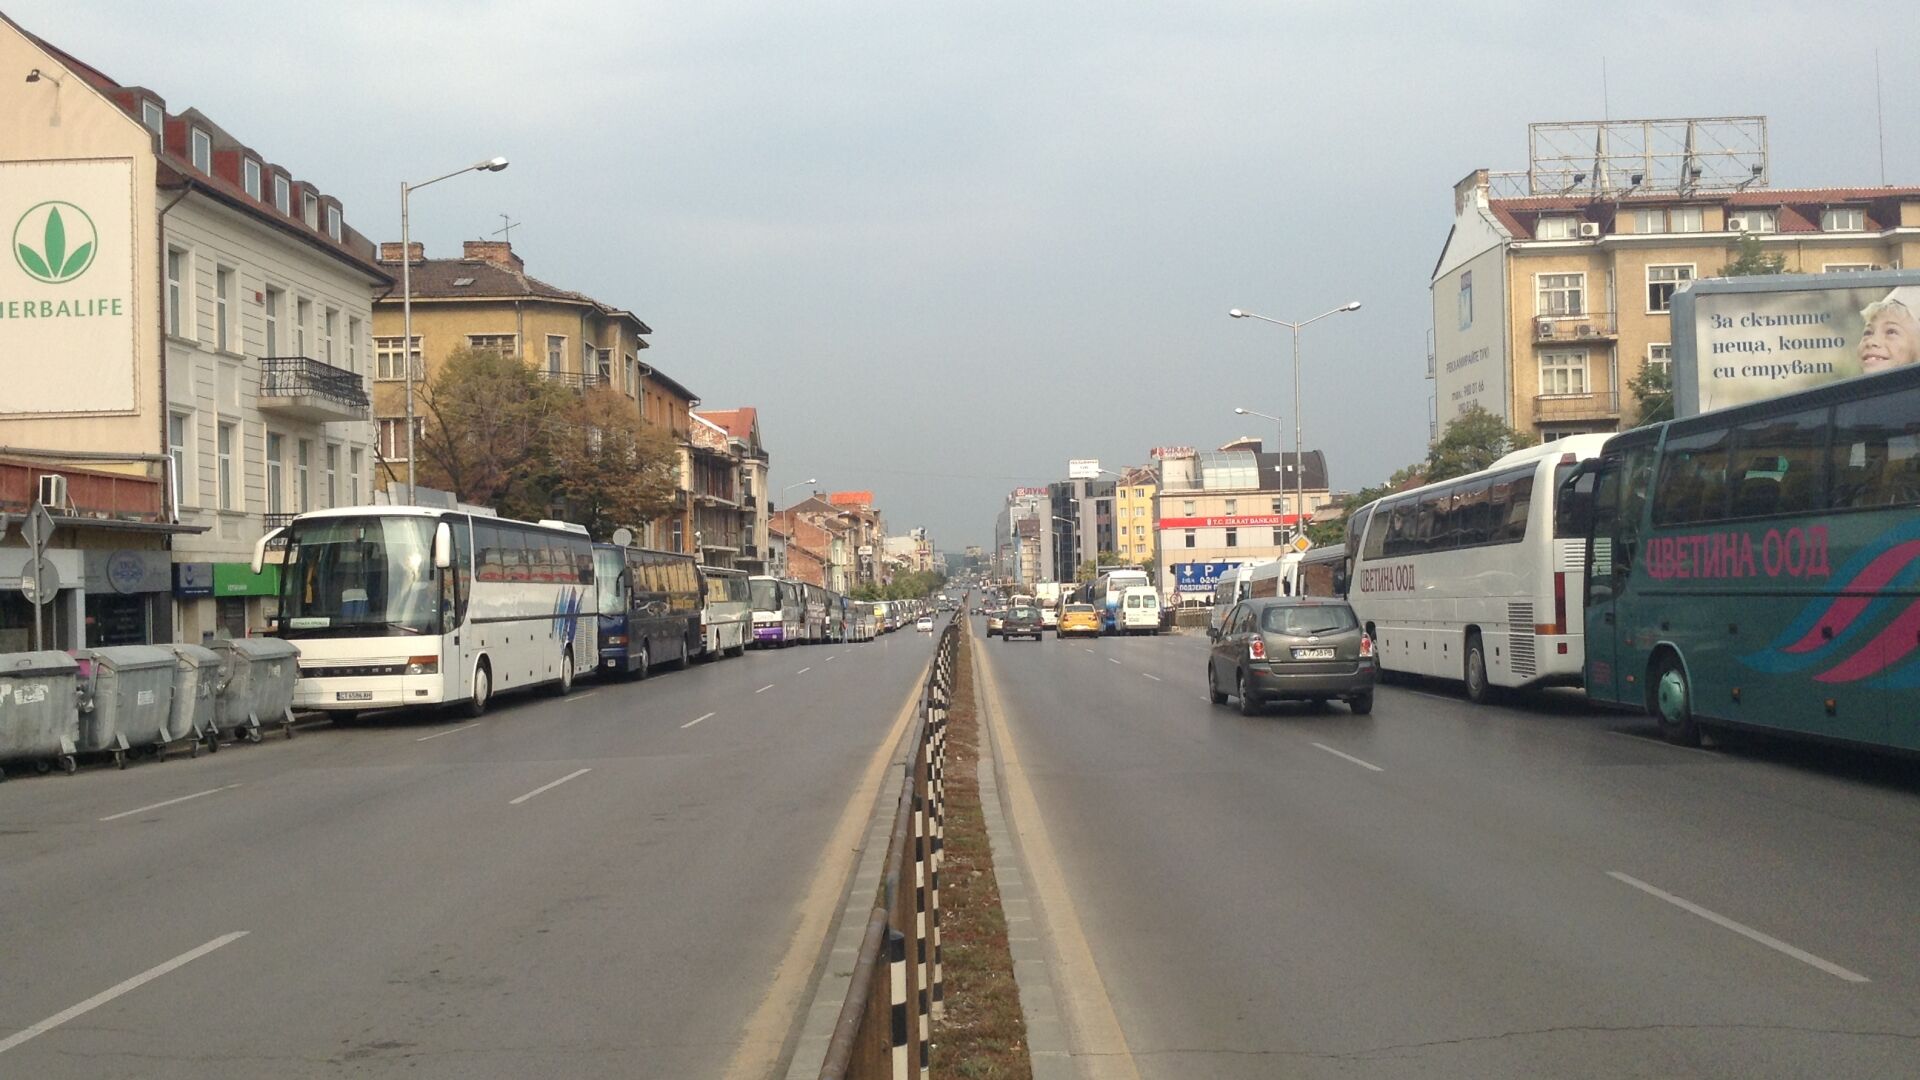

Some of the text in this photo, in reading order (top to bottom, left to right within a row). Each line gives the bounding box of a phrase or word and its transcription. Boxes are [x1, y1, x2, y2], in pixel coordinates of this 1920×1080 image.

[0, 298, 123, 319] ERBALIFE
[1711, 311, 1832, 329] За скъпите
[1712, 335, 1846, 354] неща, които
[1713, 359, 1833, 380] си струват
[1646, 525, 1831, 581] ЦВЕТИНА ООД
[1204, 565, 1214, 577] P
[1360, 564, 1416, 593] ЦВЕТИНА ООД
